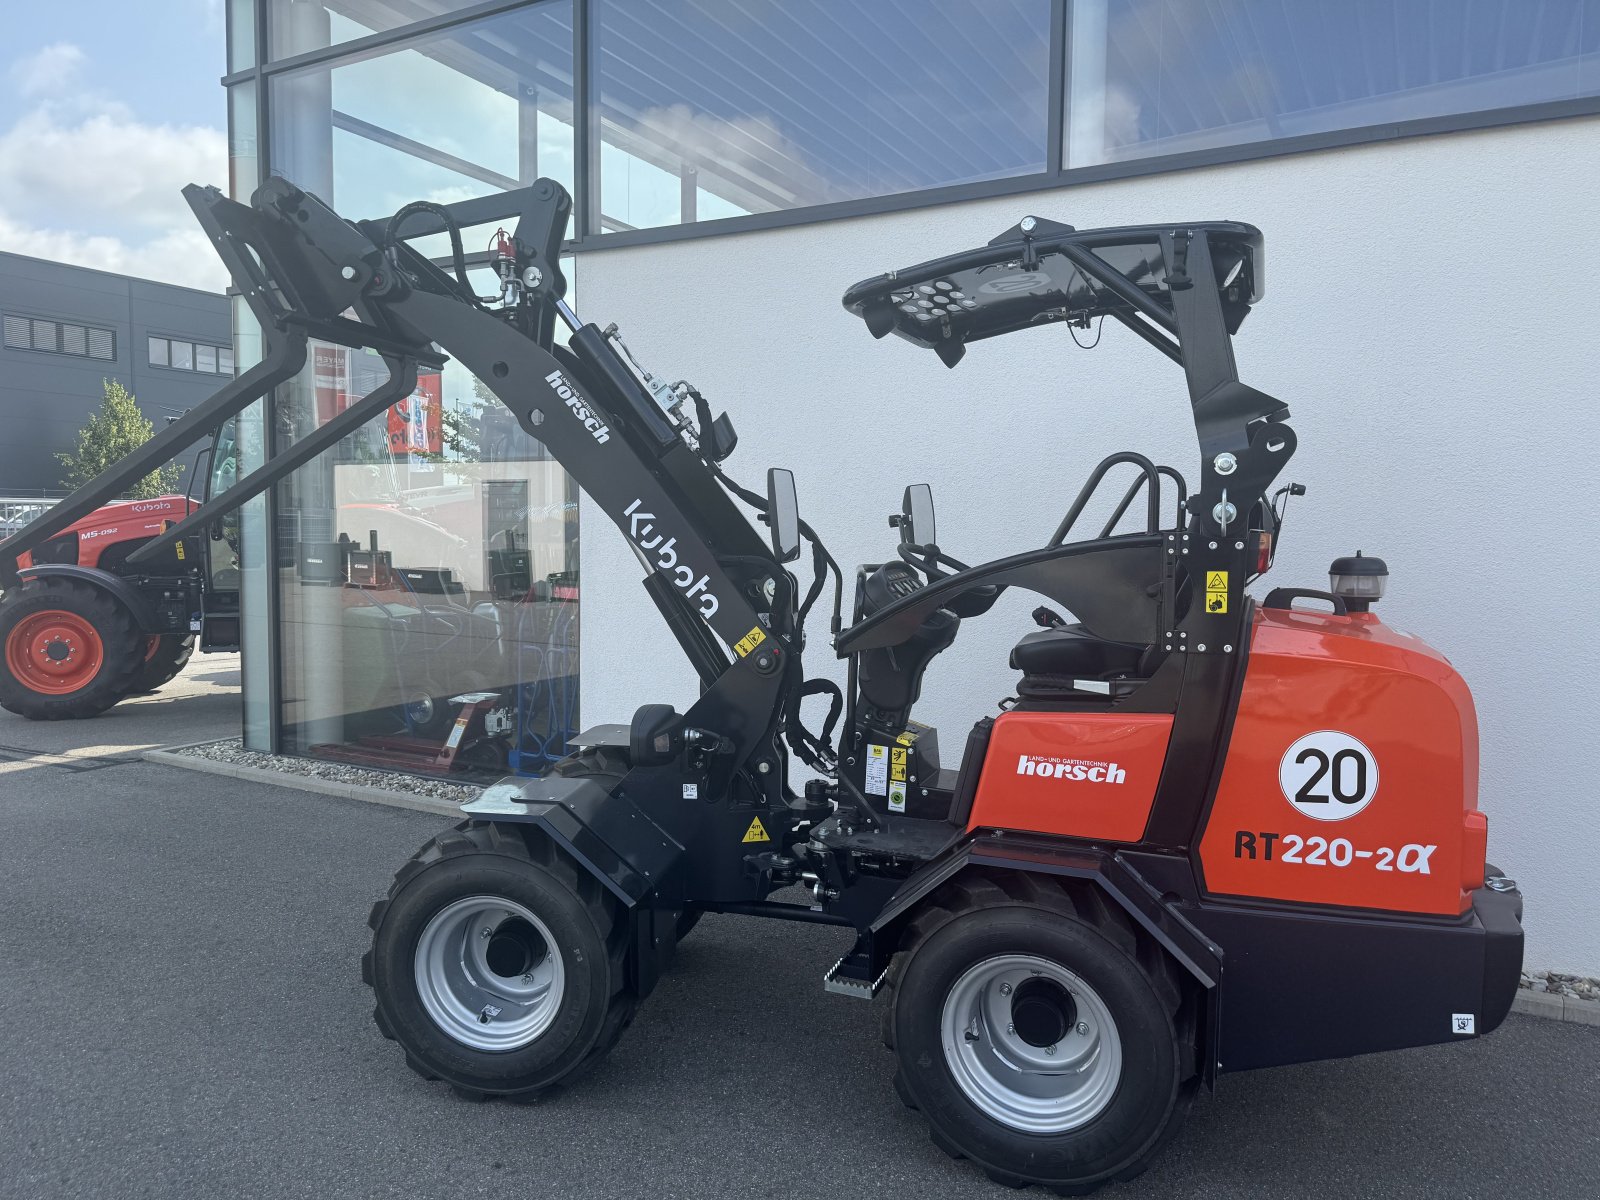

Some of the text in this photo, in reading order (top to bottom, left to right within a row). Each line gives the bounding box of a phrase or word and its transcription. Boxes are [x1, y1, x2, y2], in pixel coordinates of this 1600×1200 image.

[544, 369, 610, 445] horsch
[131, 502, 171, 512] Kubota
[81, 527, 118, 540] M5-092
[623, 498, 719, 620] Kubota
[1017, 754, 1126, 784] horsch
[1062, 758, 1109, 768] GARTENTECHNIK
[1295, 748, 1367, 804] 20
